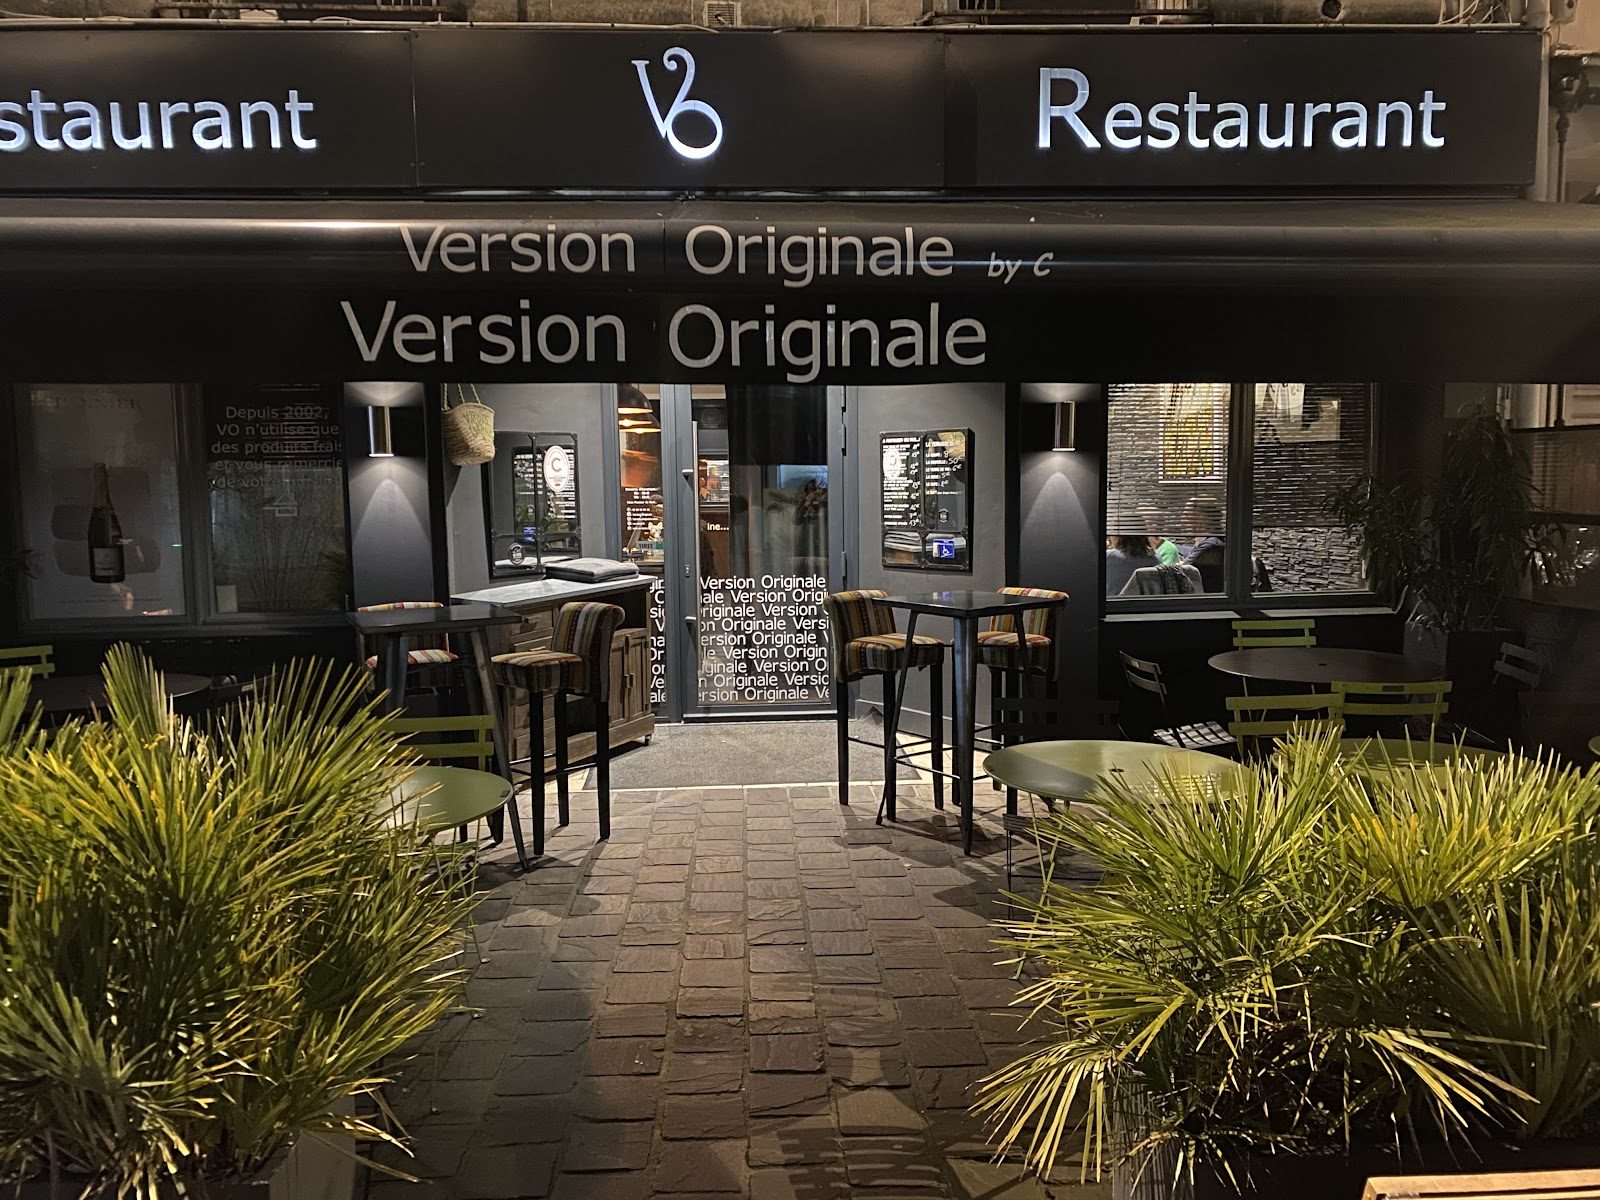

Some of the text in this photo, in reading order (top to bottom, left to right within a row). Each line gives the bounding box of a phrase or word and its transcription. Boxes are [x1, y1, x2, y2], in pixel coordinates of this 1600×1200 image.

[1037, 67, 1447, 150] Restaurant
[0, 89, 318, 152] staurant
[400, 224, 1053, 289] Version Originale by C
[340, 299, 989, 385] Version Originale
[226, 406, 329, 421] Depuis 2002,
[216, 424, 240, 436] VO
[311, 425, 340, 438] que
[211, 441, 239, 454] des
[245, 440, 311, 456] produits
[700, 574, 827, 590] Version Originale
[731, 589, 786, 604] Version
[701, 603, 817, 619] riginale Version
[721, 617, 786, 634] Originale
[752, 631, 817, 648] Originale
[723, 646, 778, 659] Version
[784, 645, 828, 662] Origin
[754, 660, 809, 673] Version
[713, 674, 778, 690] Originale
[744, 687, 809, 703] Originale
